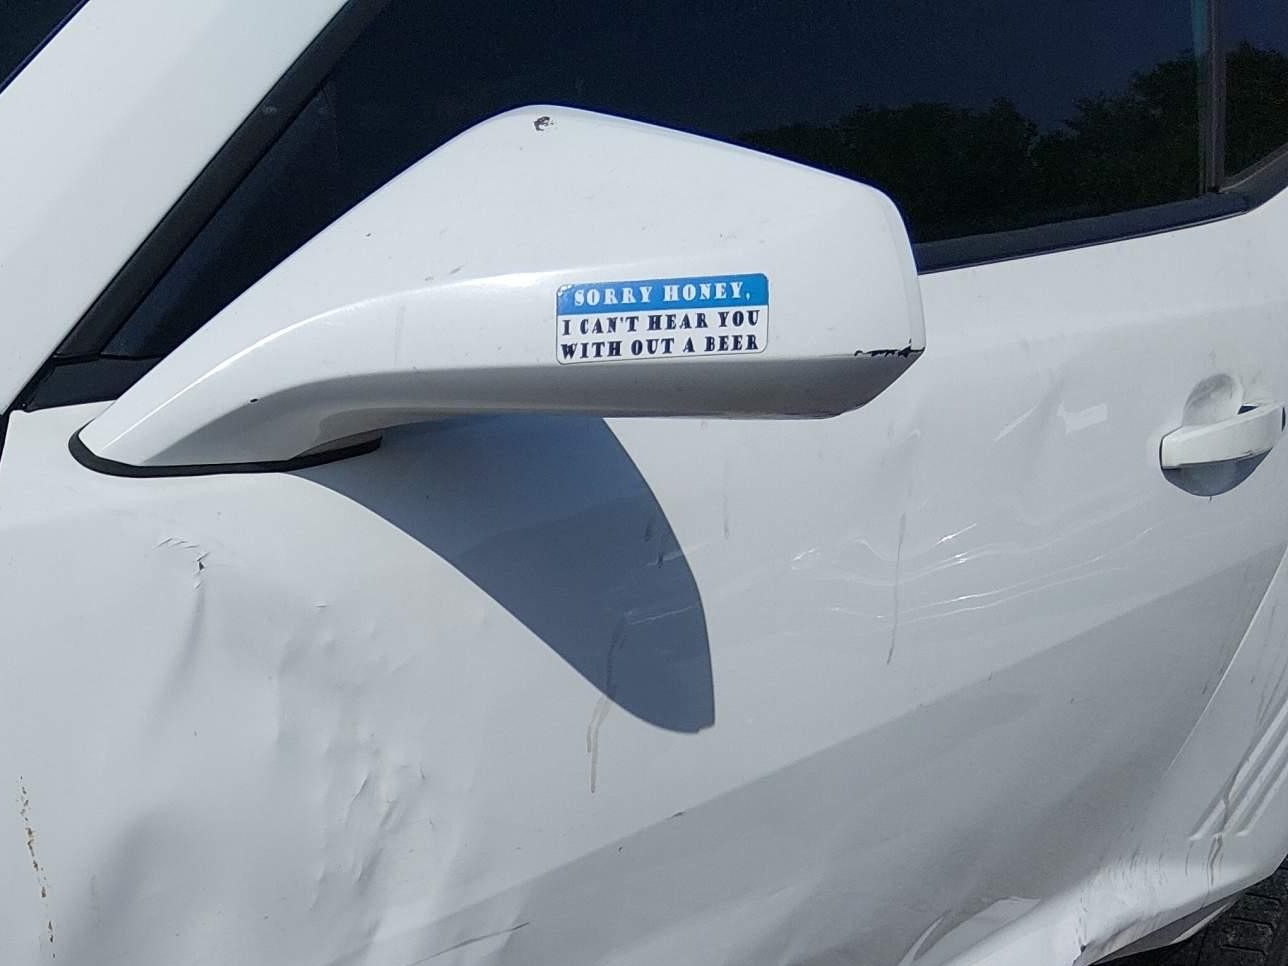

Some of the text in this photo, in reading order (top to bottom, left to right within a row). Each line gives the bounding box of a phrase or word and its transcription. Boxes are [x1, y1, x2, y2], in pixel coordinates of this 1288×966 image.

[574, 282, 751, 306] SORRY HONEY,
[562, 310, 760, 336] I CAN'T HEAR YOU
[560, 334, 759, 360] WITH OUT A BEER
